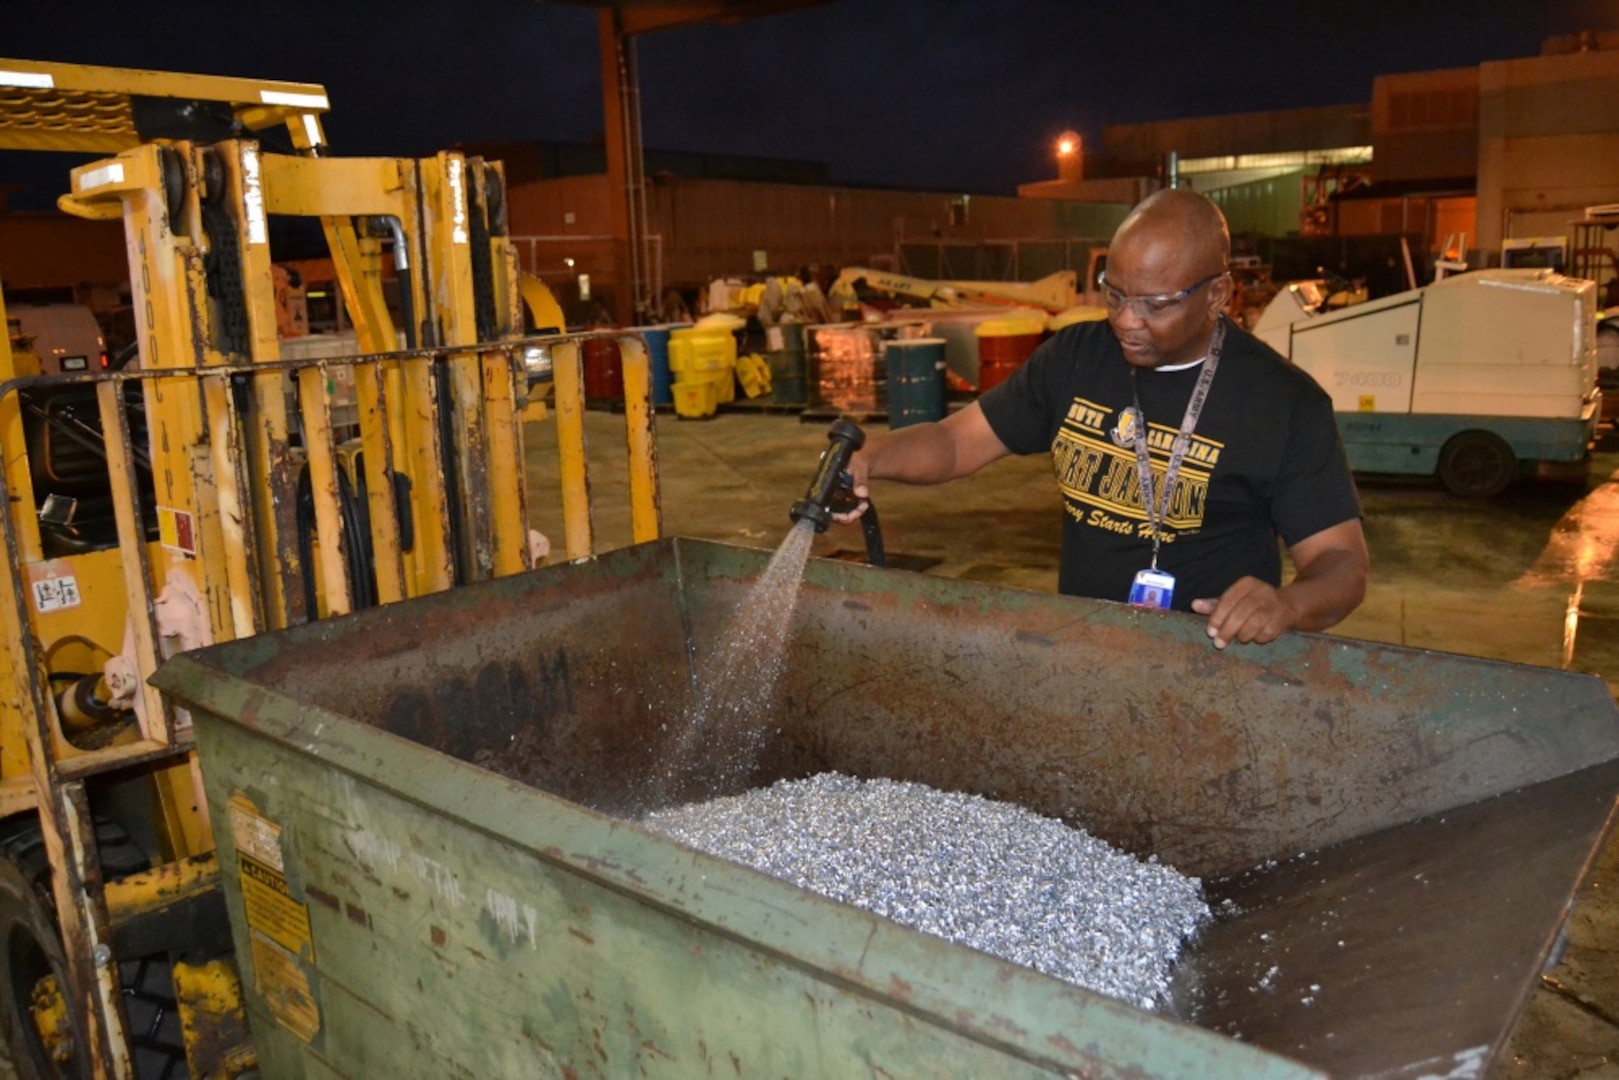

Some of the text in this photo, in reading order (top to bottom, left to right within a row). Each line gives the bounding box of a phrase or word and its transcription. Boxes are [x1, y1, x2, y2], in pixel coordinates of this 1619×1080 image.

[1333, 371, 1402, 387] 7400
[1147, 429, 1220, 464] CARINA
[1098, 455, 1208, 519] JACON
[1086, 509, 1134, 536] Starts
[250, 865, 290, 897] CAUTIO
